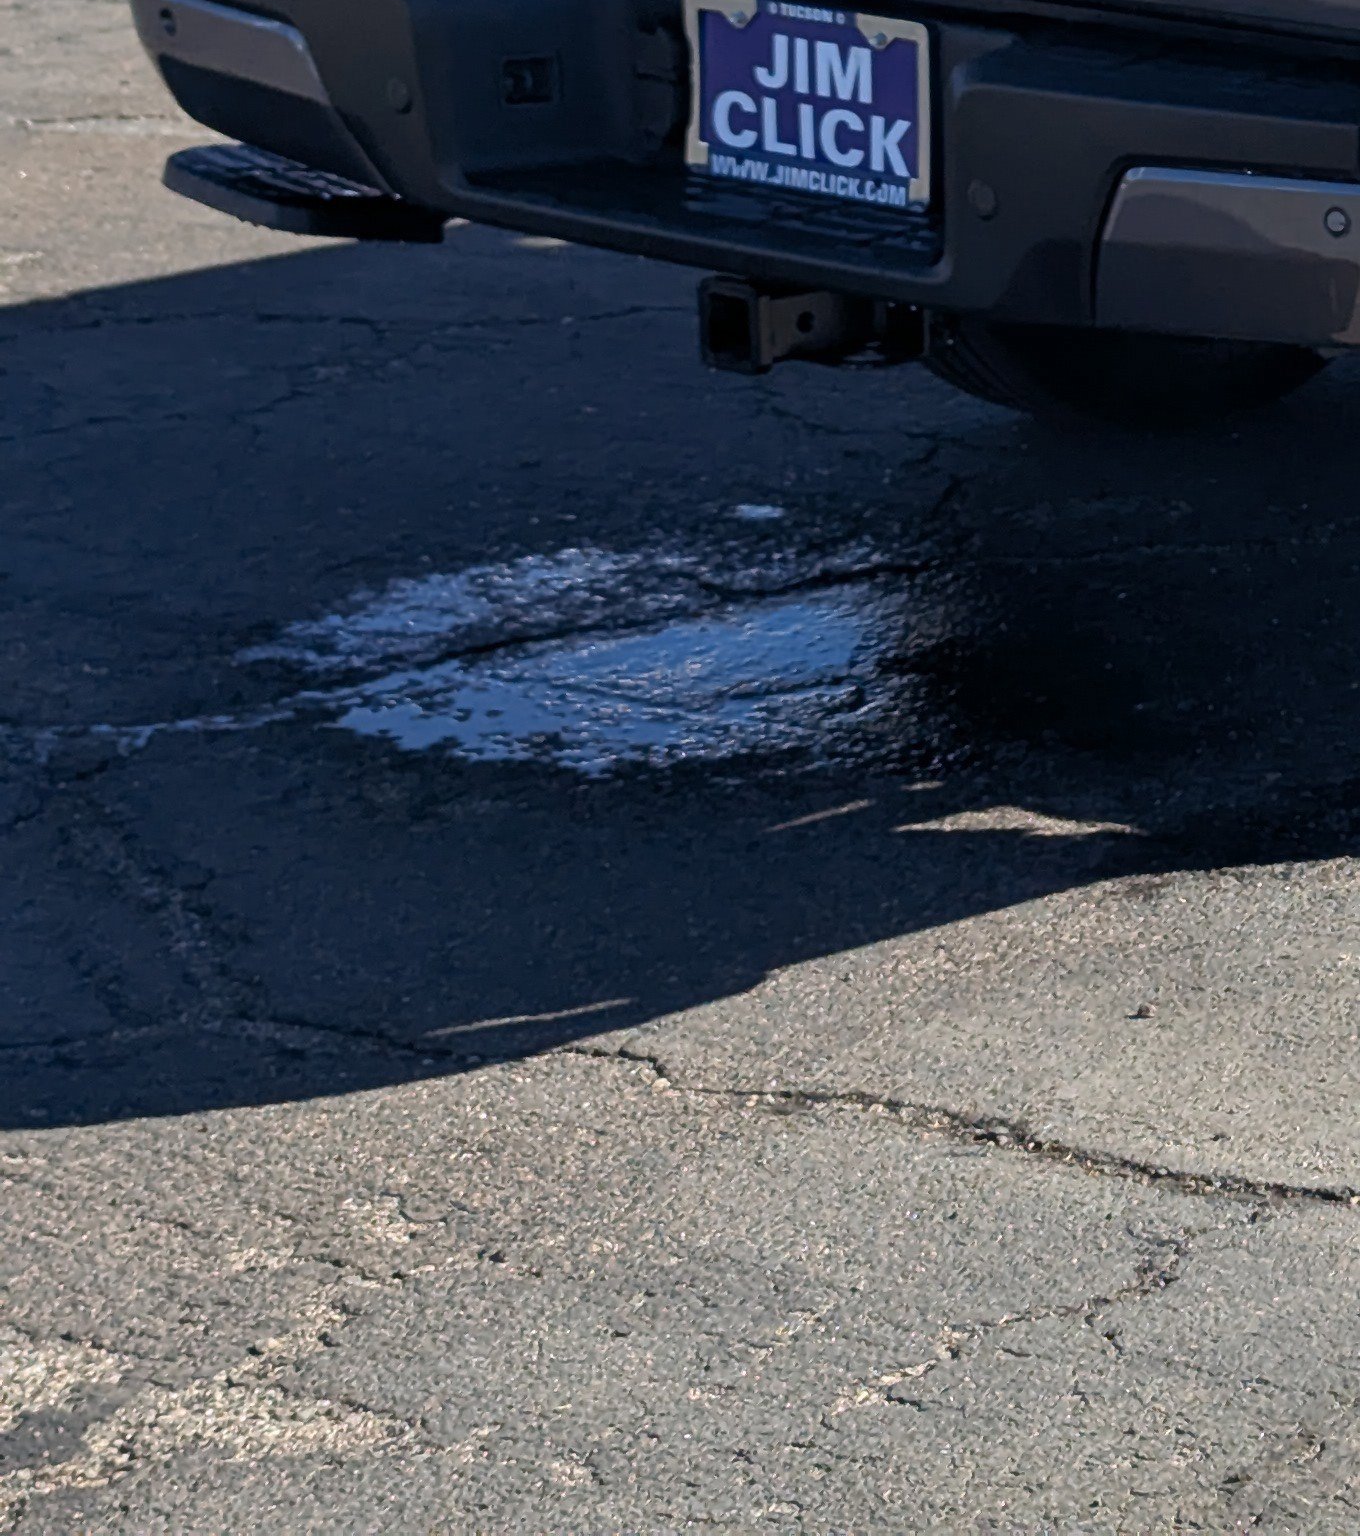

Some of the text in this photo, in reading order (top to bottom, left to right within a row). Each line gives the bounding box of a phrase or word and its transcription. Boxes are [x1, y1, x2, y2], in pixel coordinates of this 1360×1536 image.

[753, 33, 873, 105] JIM
[711, 89, 914, 179] CLICK
[710, 153, 907, 207] WWW.JIMCLICK.COM
